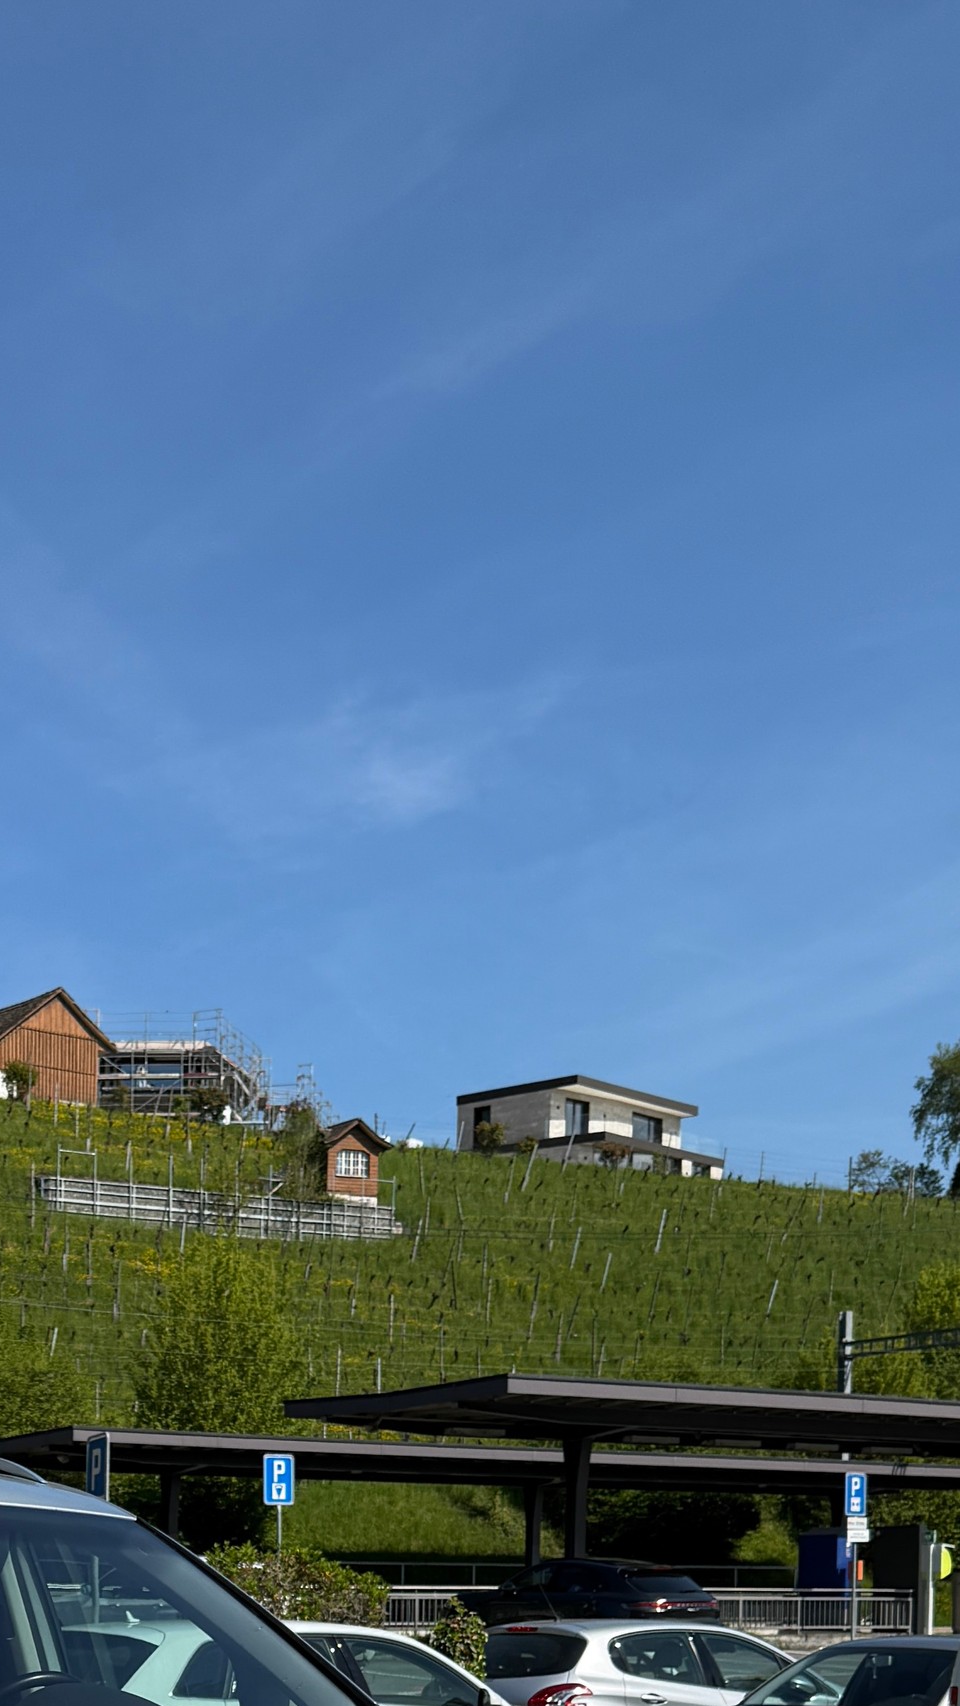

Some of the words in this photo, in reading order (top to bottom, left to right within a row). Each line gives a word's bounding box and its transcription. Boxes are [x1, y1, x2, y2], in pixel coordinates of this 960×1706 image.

[91, 1448, 101, 1490] P
[273, 1460, 285, 1482] P
[851, 1477, 860, 1496] P
